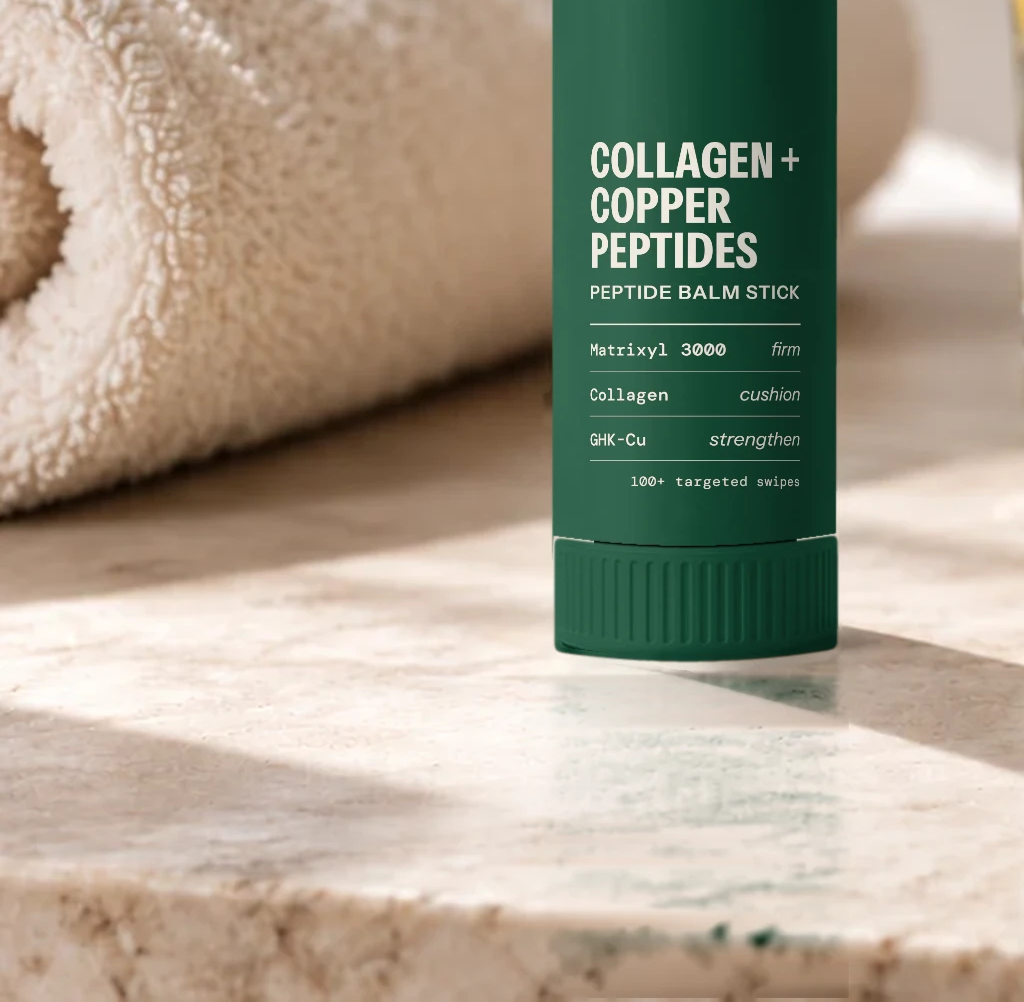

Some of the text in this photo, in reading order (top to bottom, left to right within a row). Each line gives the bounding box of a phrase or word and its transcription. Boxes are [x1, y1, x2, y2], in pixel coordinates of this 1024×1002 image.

[591, 142, 799, 179] COLLAGEN +
[591, 187, 731, 223] COPPER
[592, 232, 757, 269] PEPTIDES
[591, 285, 799, 299] PEPTIDE BALM STICK
[591, 343, 726, 359] Matrixyl 3000
[772, 342, 800, 356] firm
[590, 388, 668, 405] Collagen
[740, 387, 800, 401] cushion
[590, 433, 646, 446] GHK-Cu
[709, 432, 800, 450] strengthen
[631, 476, 799, 489] 100+ targeted swipes
